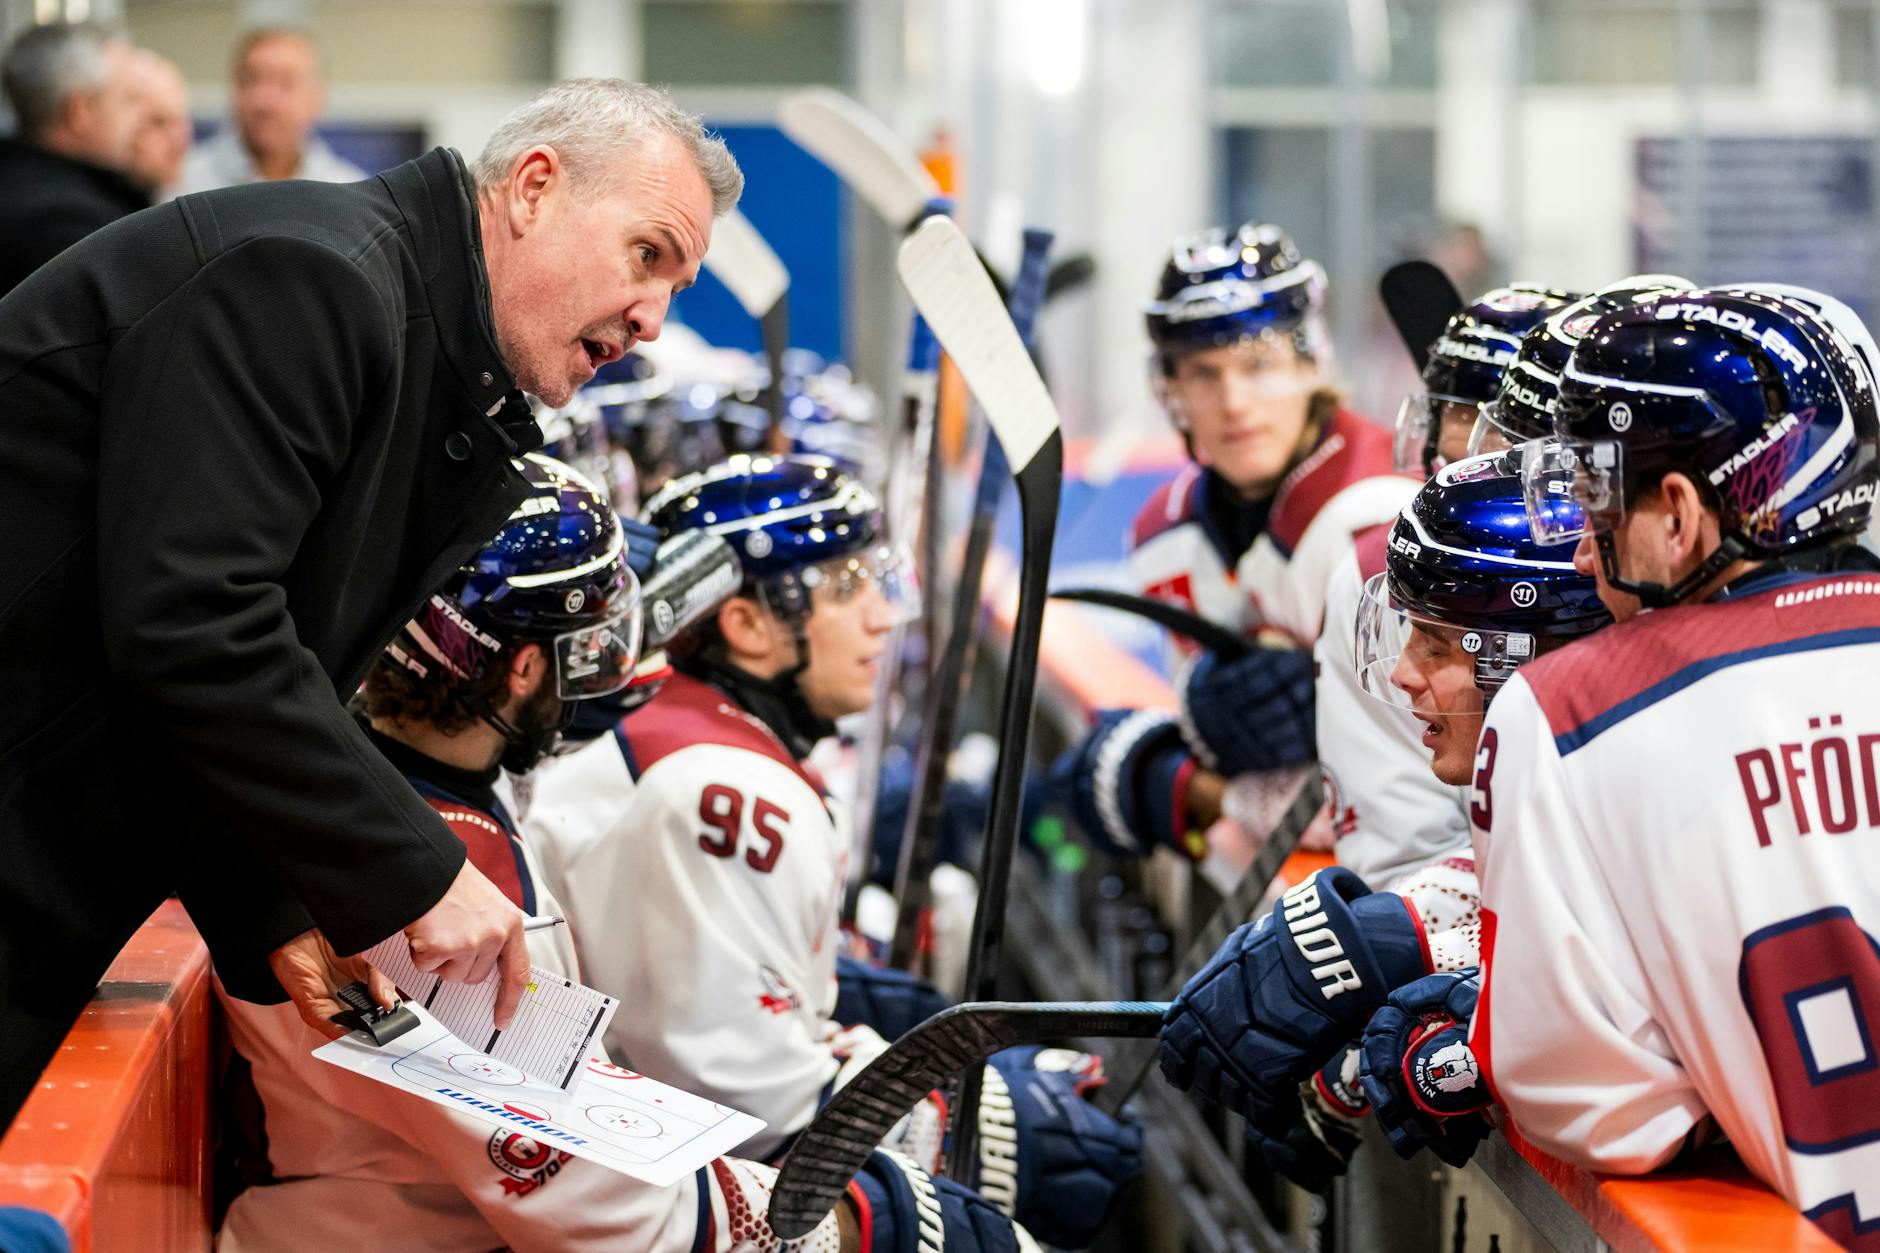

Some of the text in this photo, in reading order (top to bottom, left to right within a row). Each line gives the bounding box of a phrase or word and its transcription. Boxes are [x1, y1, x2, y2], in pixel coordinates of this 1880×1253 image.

[1655, 303, 1808, 374] STADLER
[1708, 412, 1799, 487] STADLER
[430, 594, 502, 653] STADLER
[698, 783, 790, 874] 95
[1415, 1057, 1437, 1098] BERLIN
